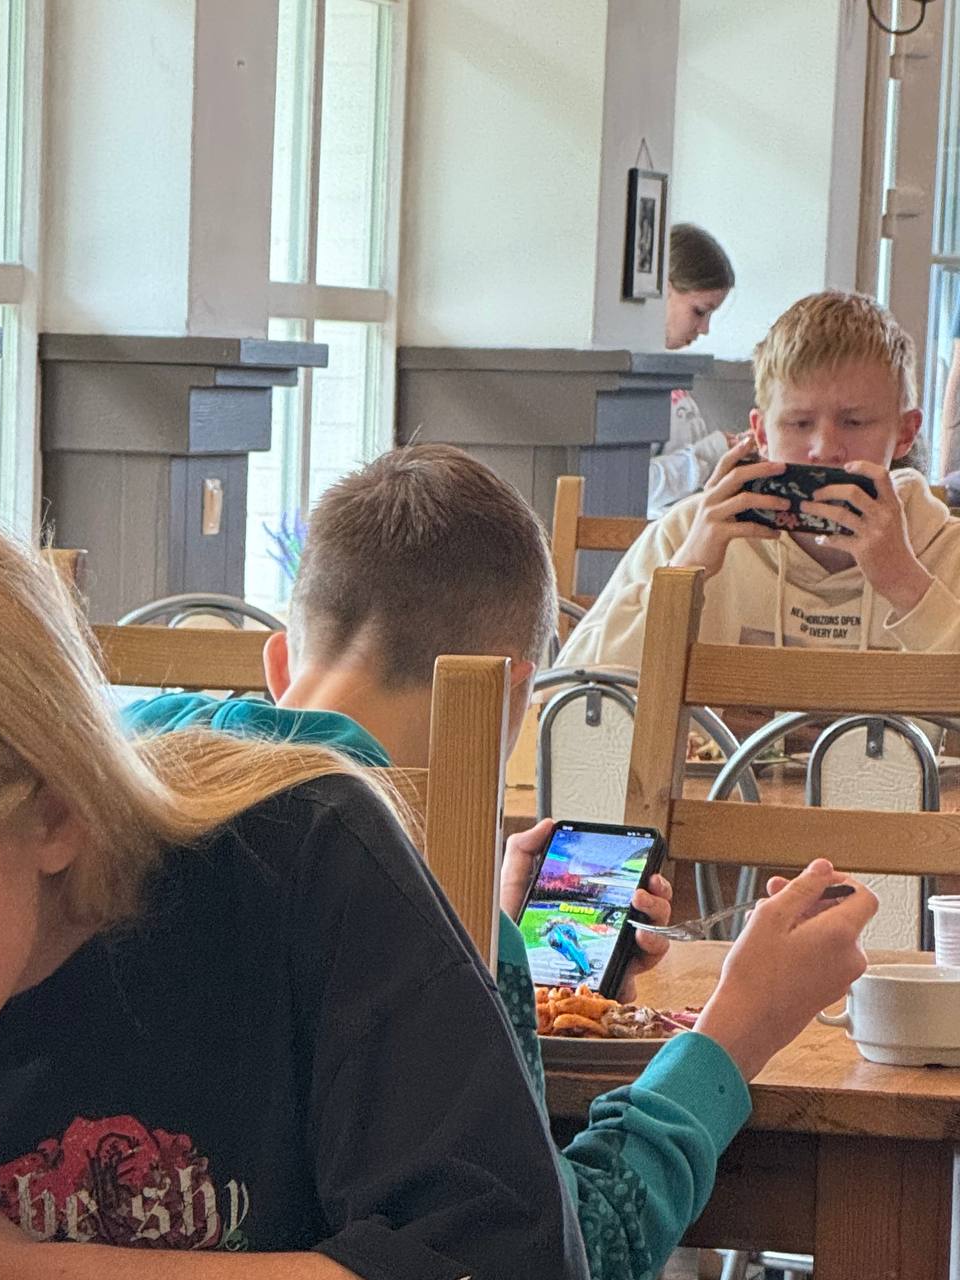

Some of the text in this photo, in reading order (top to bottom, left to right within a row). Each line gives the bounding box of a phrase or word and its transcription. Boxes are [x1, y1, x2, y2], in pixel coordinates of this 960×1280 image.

[841, 615, 861, 627] OPEN
[809, 627, 832, 638] EVERY
[833, 628, 848, 638] DAY
[13, 1173, 100, 1243] be
[130, 1164, 250, 1251] shy
